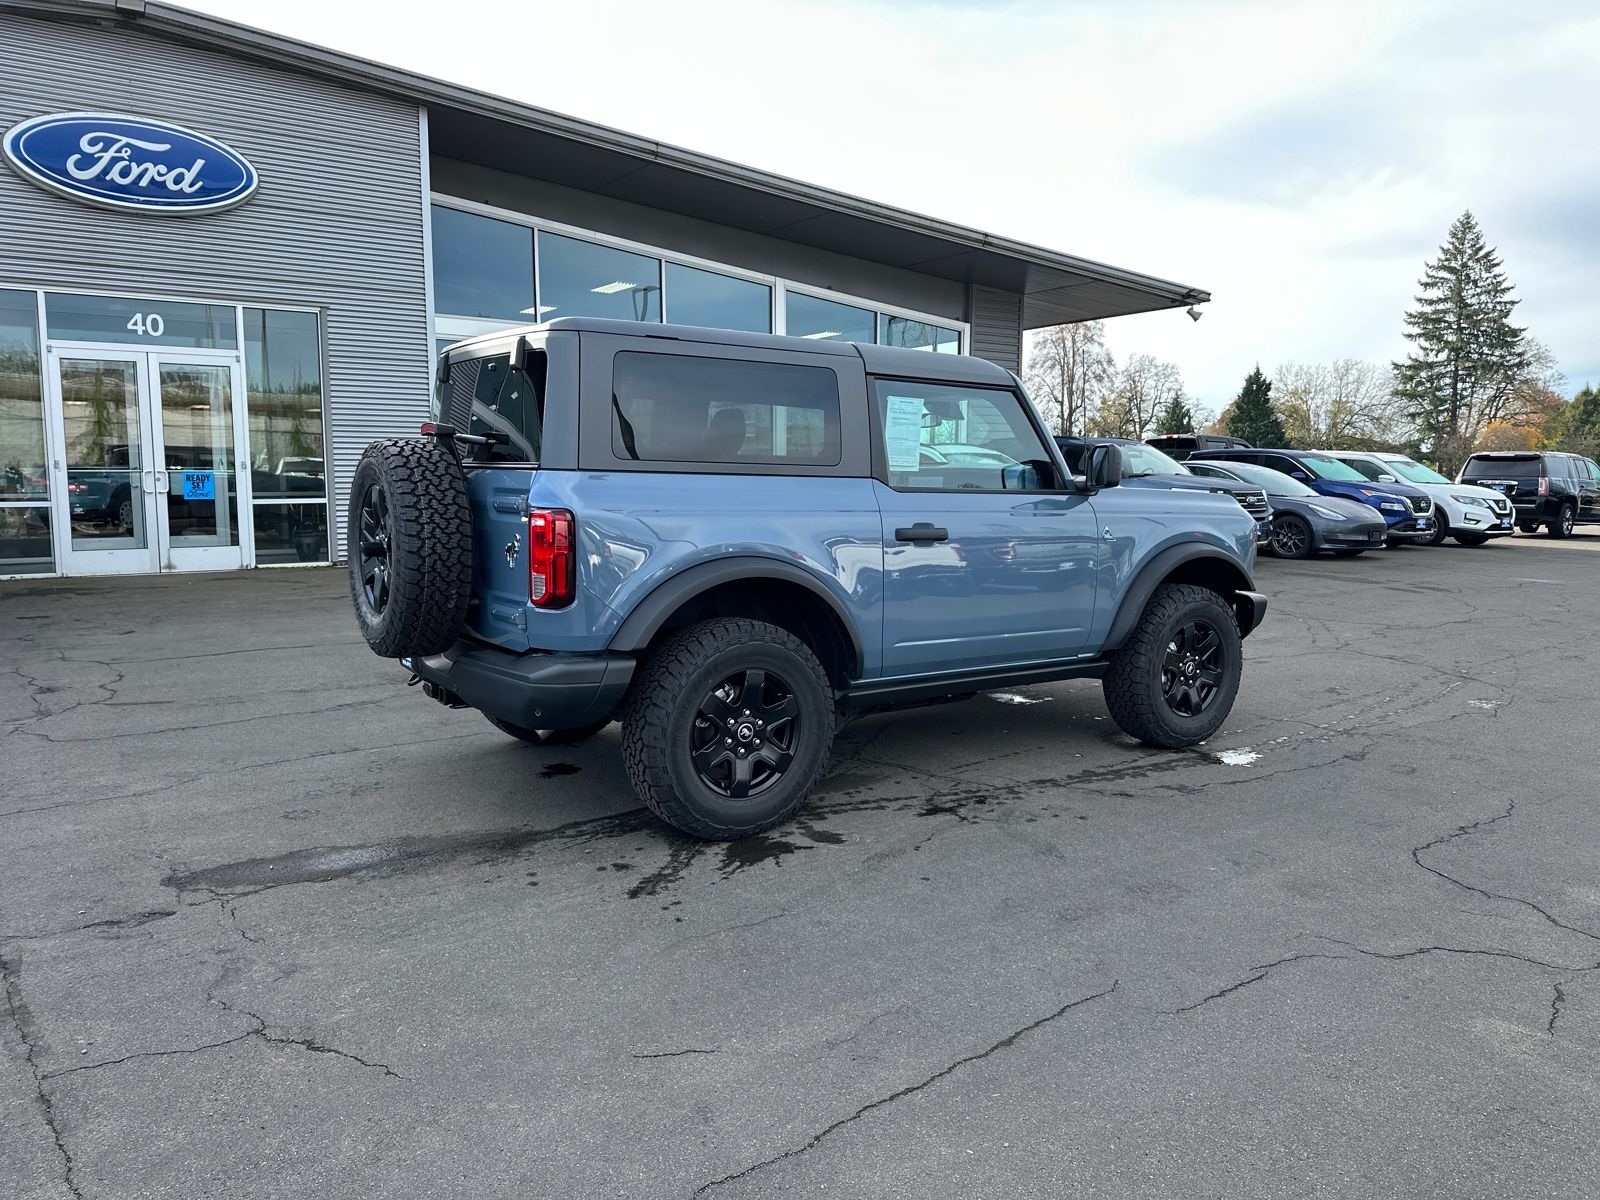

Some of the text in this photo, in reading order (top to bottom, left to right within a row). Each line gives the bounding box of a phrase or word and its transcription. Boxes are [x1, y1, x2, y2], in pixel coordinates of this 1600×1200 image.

[66, 132, 206, 194] Ford
[127, 313, 164, 337] 40
[186, 474, 210, 482] READY
[191, 481, 205, 489] SET
[187, 489, 209, 497] Ford
